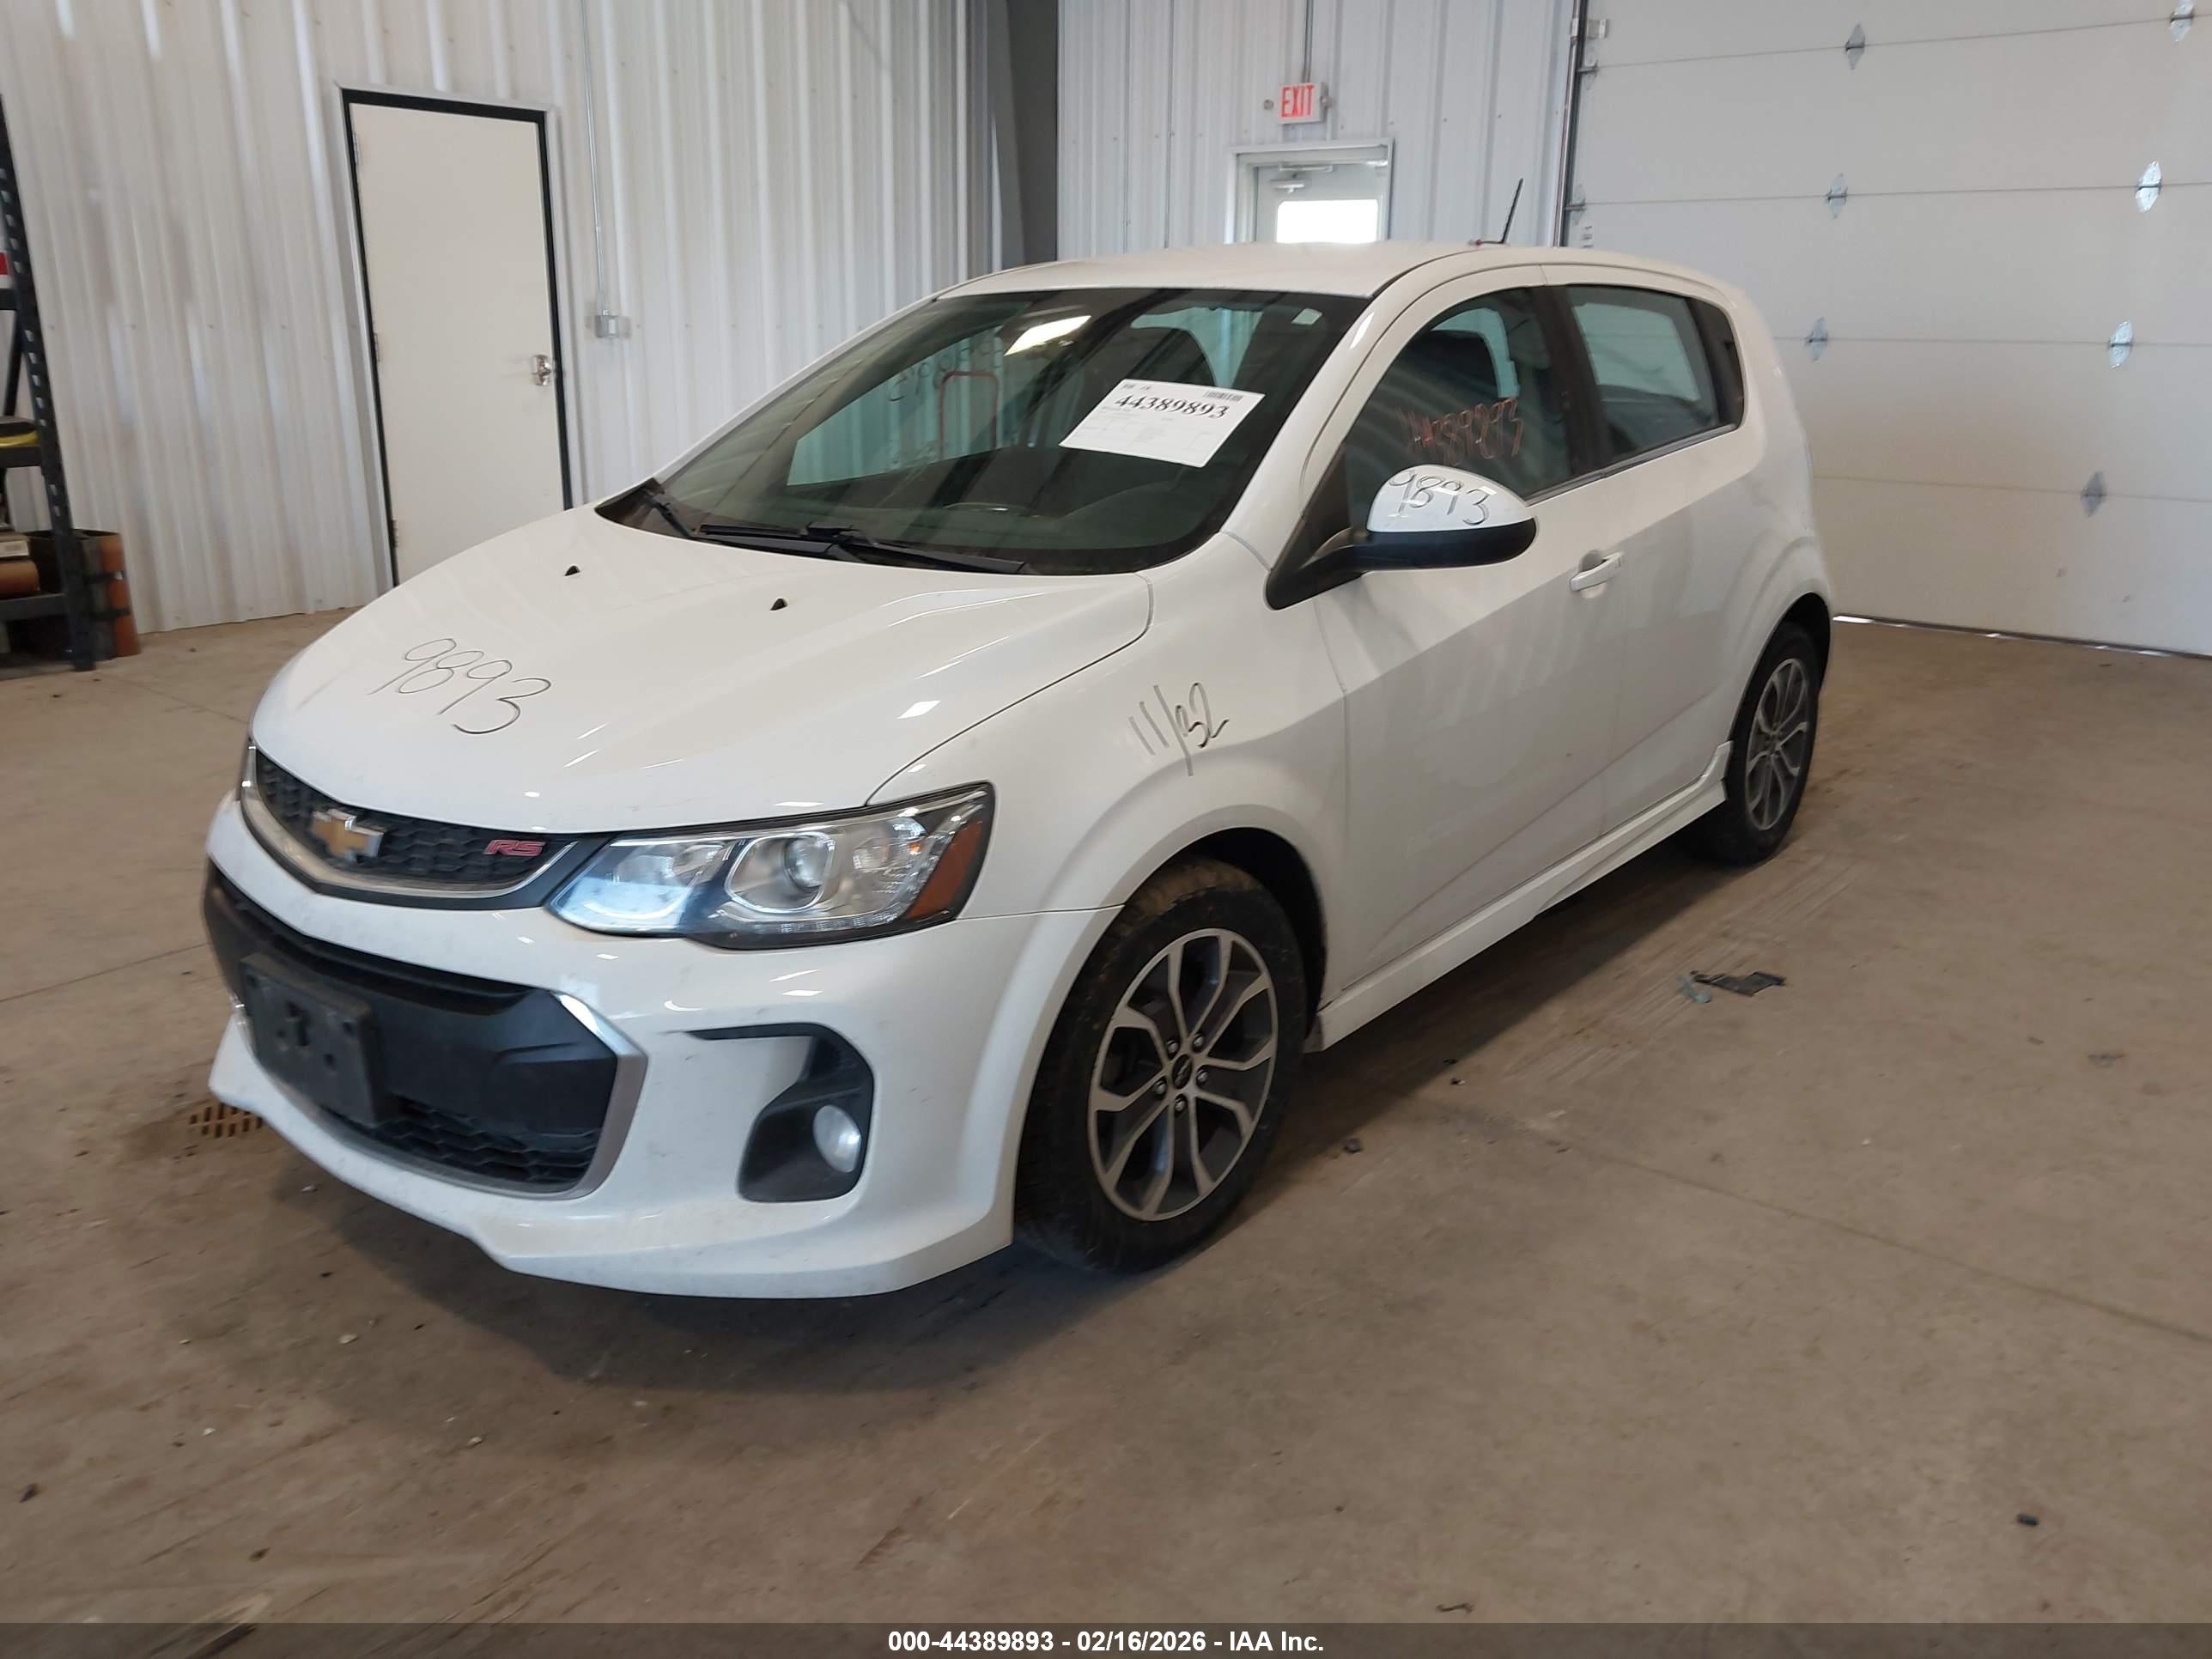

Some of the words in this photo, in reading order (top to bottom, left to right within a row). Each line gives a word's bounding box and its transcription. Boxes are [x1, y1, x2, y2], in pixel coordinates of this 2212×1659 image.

[1281, 84, 1314, 117] EXIT
[1115, 394, 1230, 419] 44389893
[1389, 471, 1490, 526] 9893
[367, 638, 551, 734] 9893
[483, 839, 547, 857] RS
